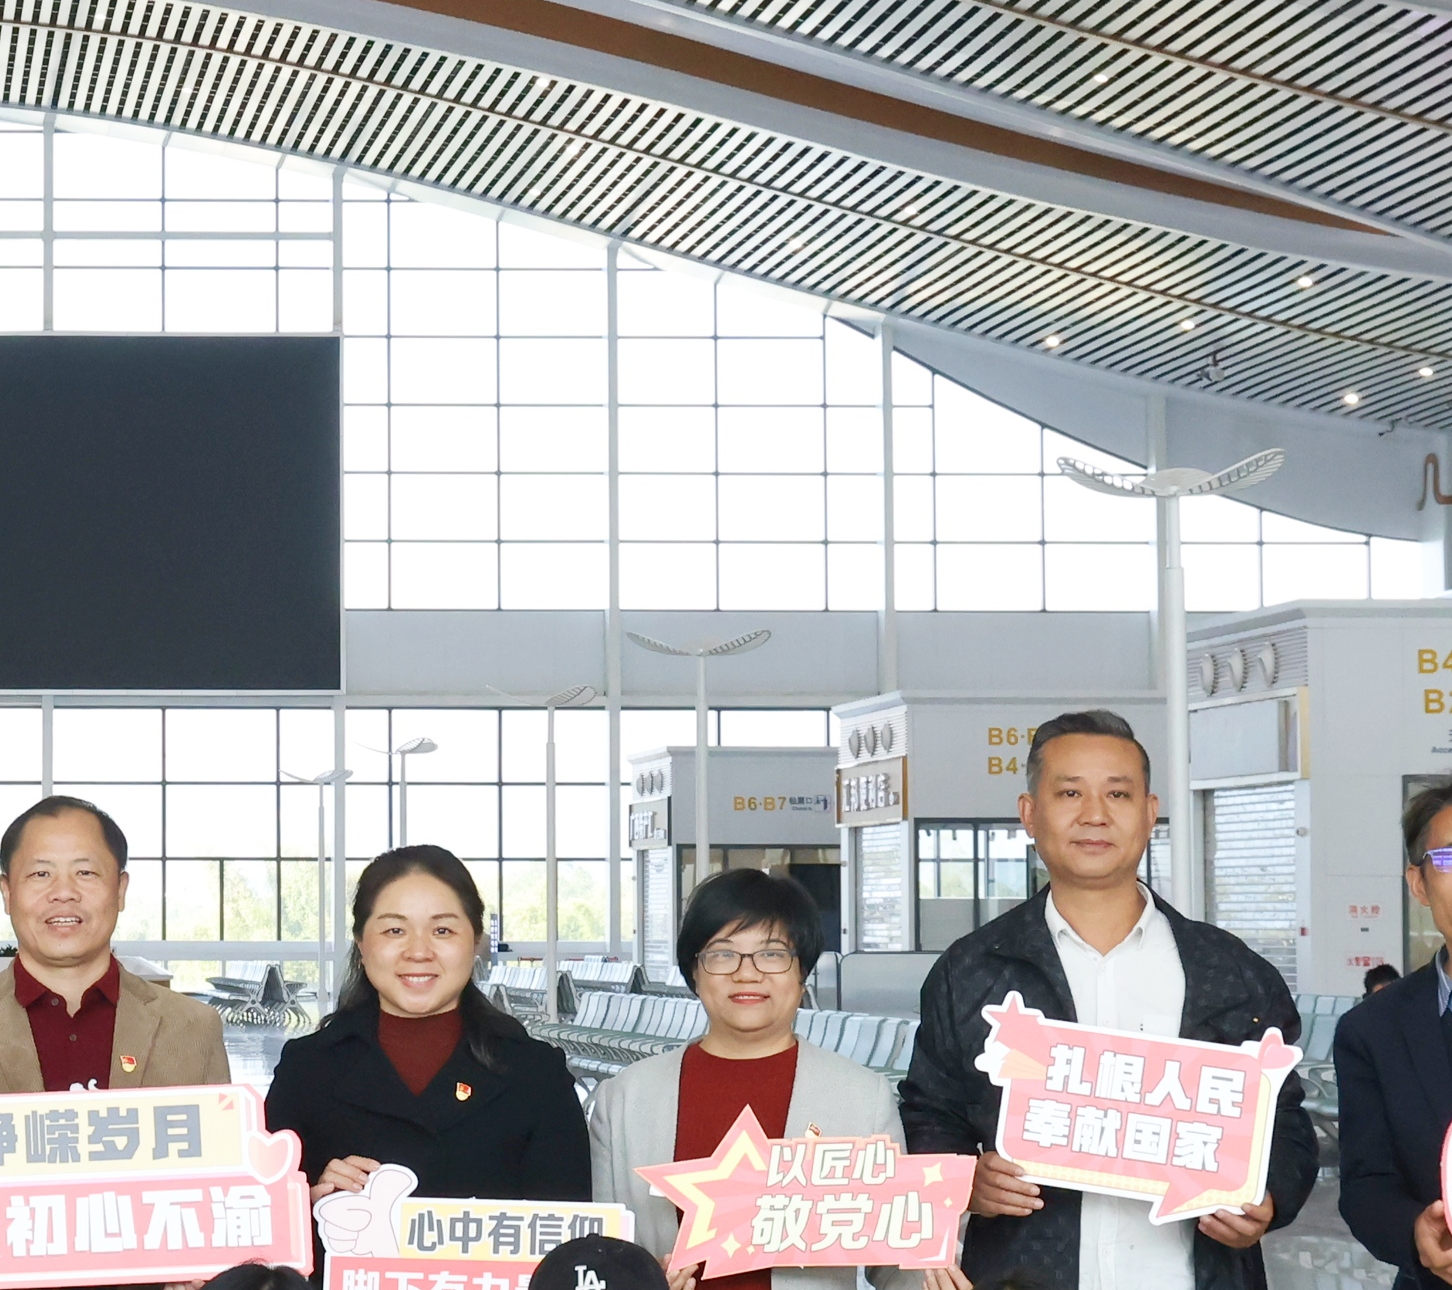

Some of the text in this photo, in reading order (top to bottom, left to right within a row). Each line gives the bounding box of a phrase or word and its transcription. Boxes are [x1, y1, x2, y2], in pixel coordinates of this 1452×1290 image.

[1045, 1042, 1246, 1118] 扎根人民
[765, 1140, 896, 1188] 以匠心
[1022, 1098, 1223, 1173] 奉献国家
[5, 1184, 274, 1258] 初心不渝
[750, 1190, 934, 1253] 敬党心
